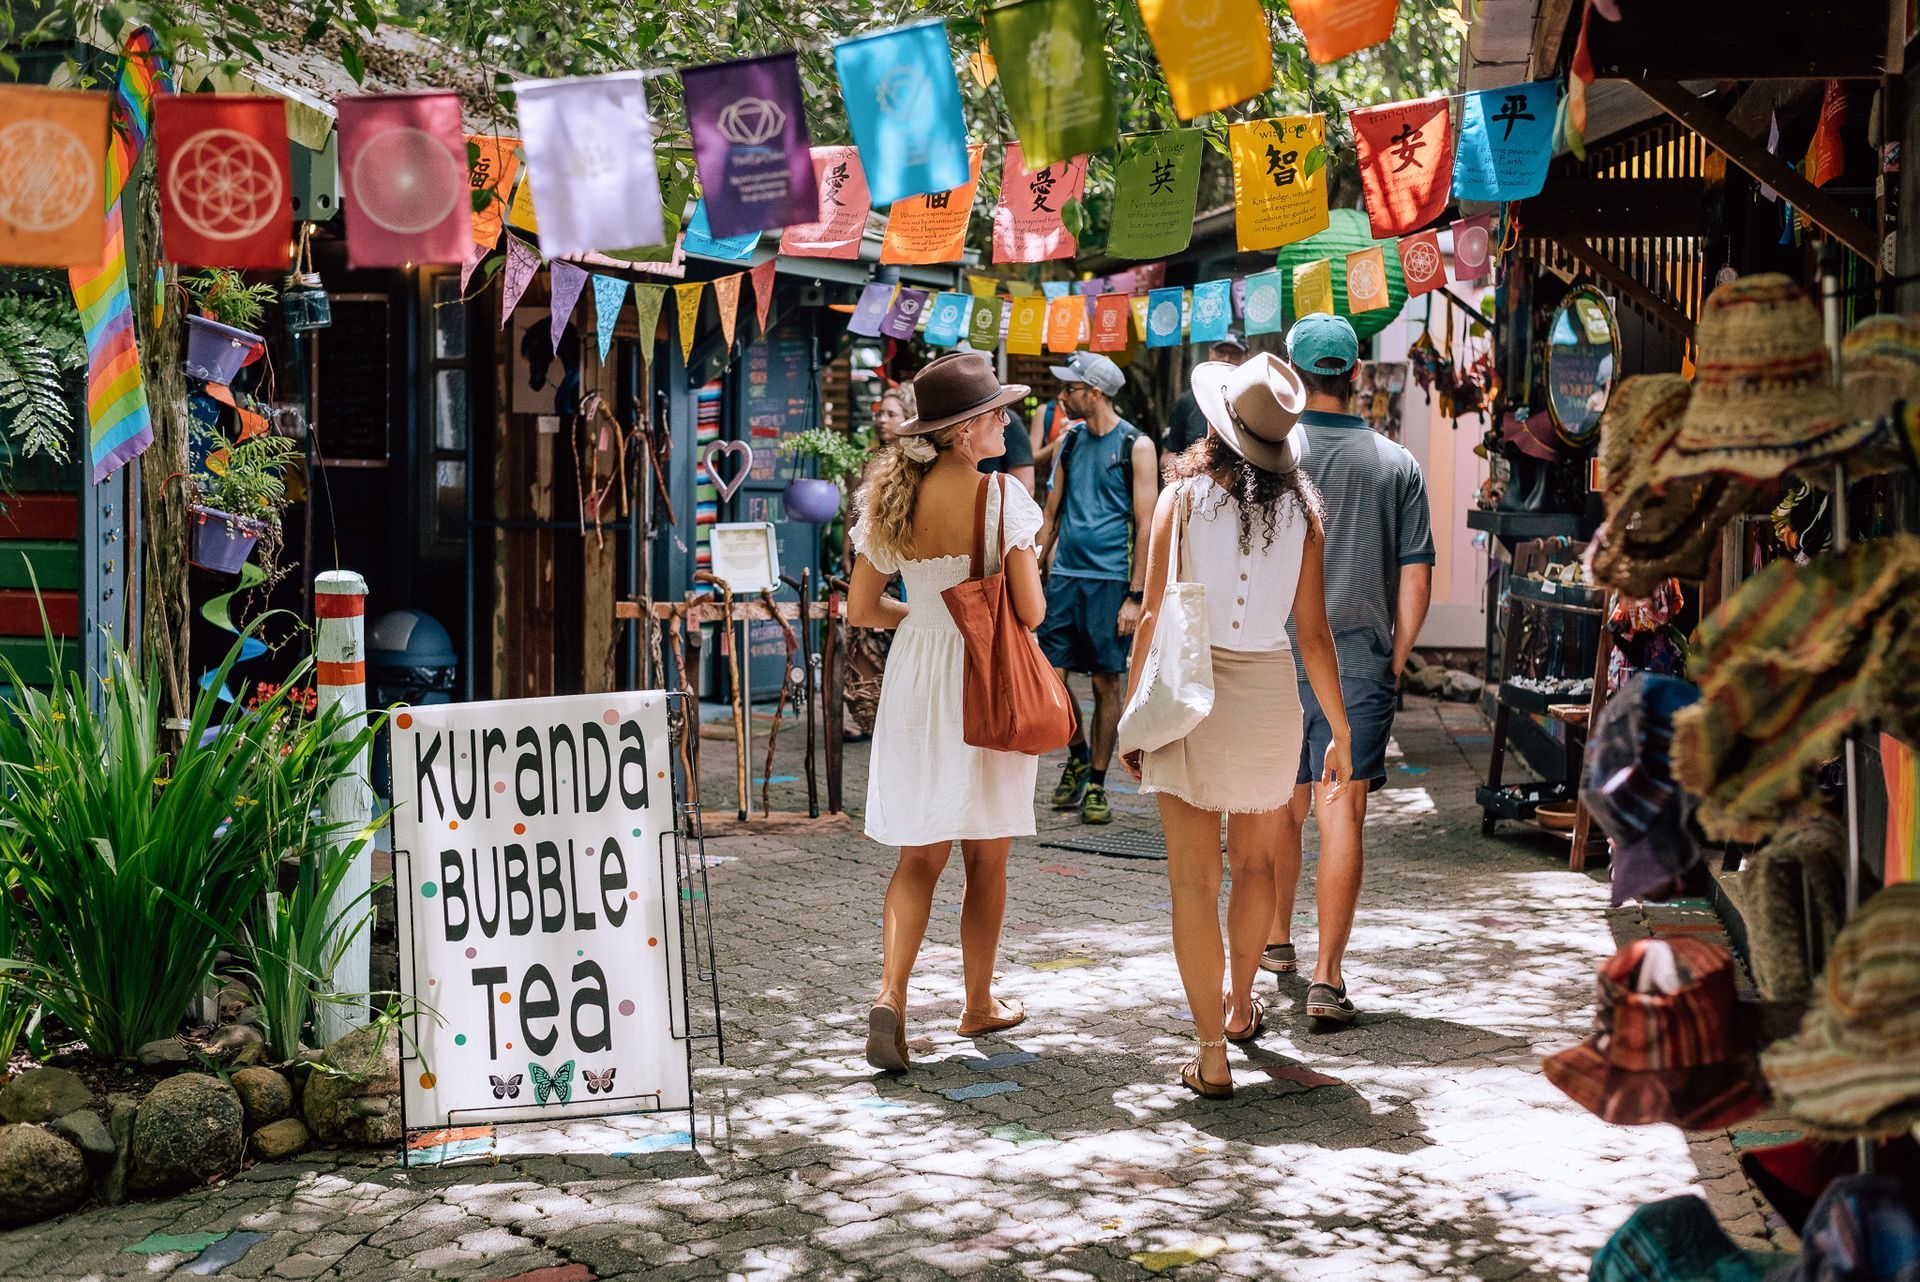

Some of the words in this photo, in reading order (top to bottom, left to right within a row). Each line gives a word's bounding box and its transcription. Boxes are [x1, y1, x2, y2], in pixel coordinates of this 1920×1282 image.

[1491, 95, 1536, 142] 平
[1265, 143, 1298, 187] 智
[1391, 123, 1427, 173] 安
[823, 162, 850, 207] 愛
[1148, 158, 1176, 196] 英
[472, 959, 612, 1060] Tea
